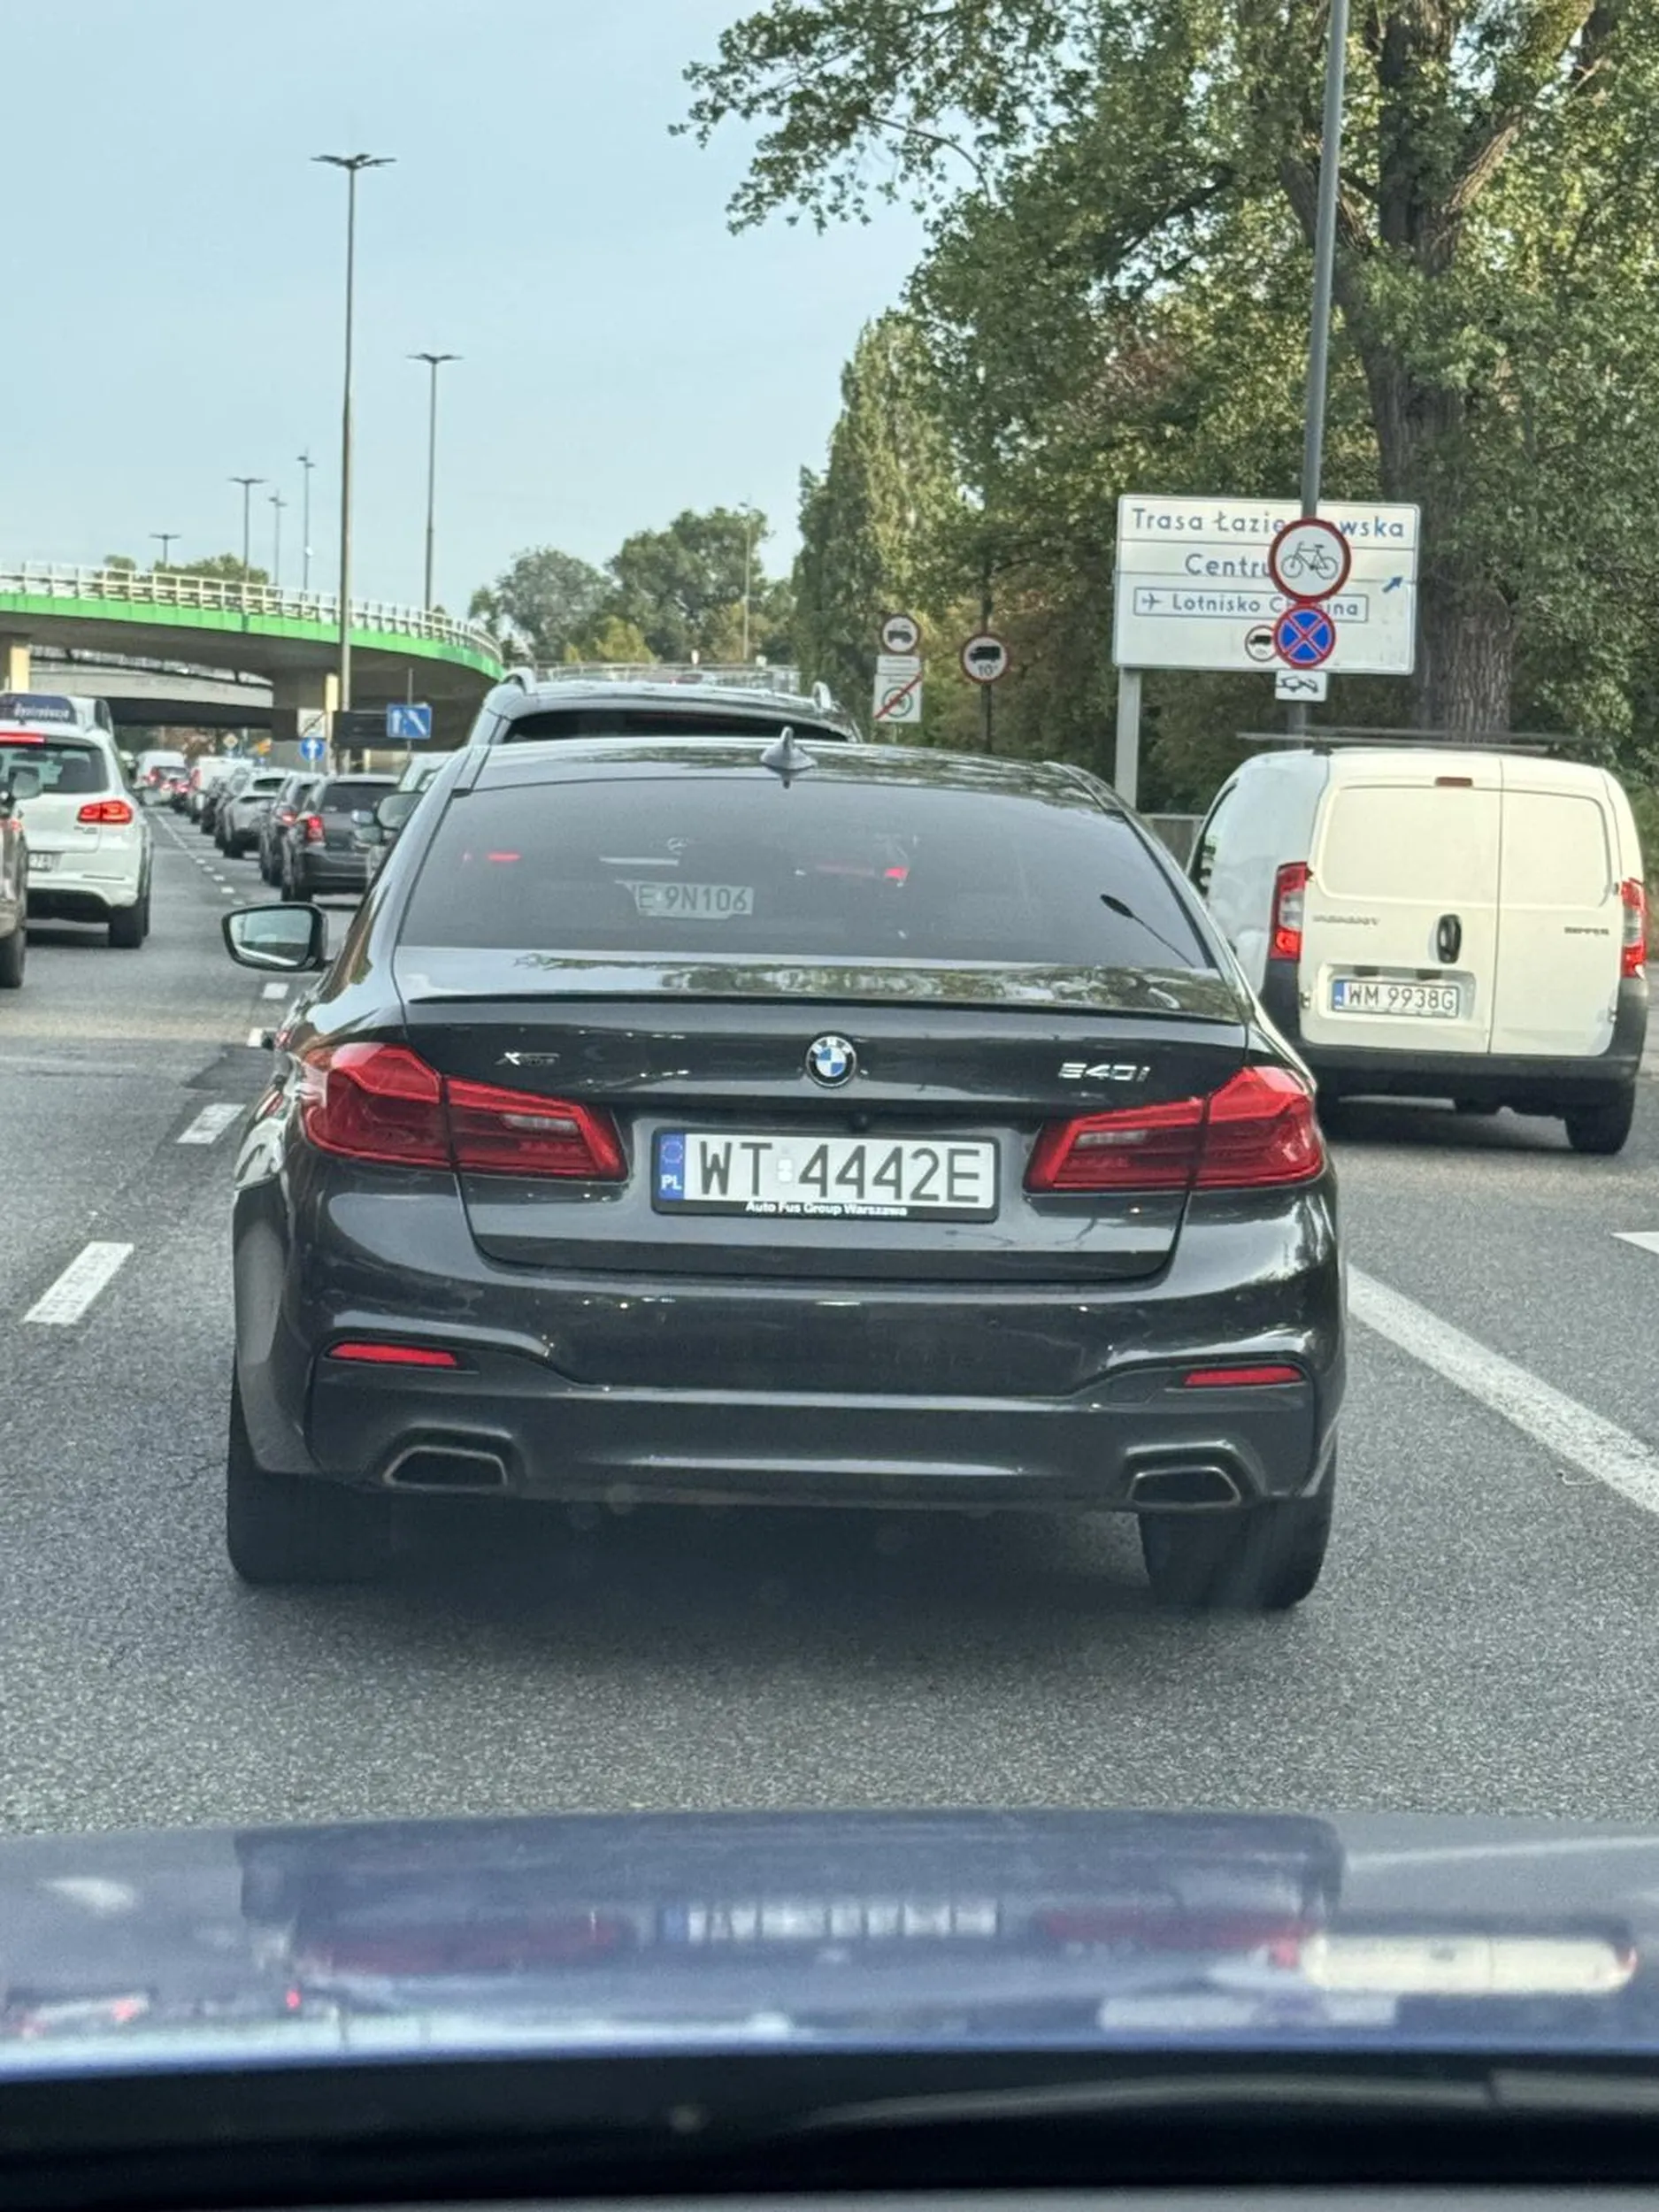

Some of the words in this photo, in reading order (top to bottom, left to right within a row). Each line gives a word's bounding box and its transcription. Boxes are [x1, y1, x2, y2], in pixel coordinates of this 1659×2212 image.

[1132, 508, 1203, 532] Trasa
[1213, 510, 1405, 538] Łaziewska
[1185, 553, 1271, 577] Centru
[1172, 593, 1261, 614] Lotnisko
[664, 885, 749, 912] 9N106
[1348, 984, 1379, 1006] WM
[1387, 987, 1455, 1010] 9938G
[660, 1174, 682, 1191] PL
[699, 1140, 773, 1196] WT
[798, 1143, 980, 1203] 4442E
[745, 1202, 776, 1213] Auto
[779, 1202, 801, 1214] Fus
[803, 1203, 841, 1217] Group
[843, 1204, 908, 1217] Warszawa
